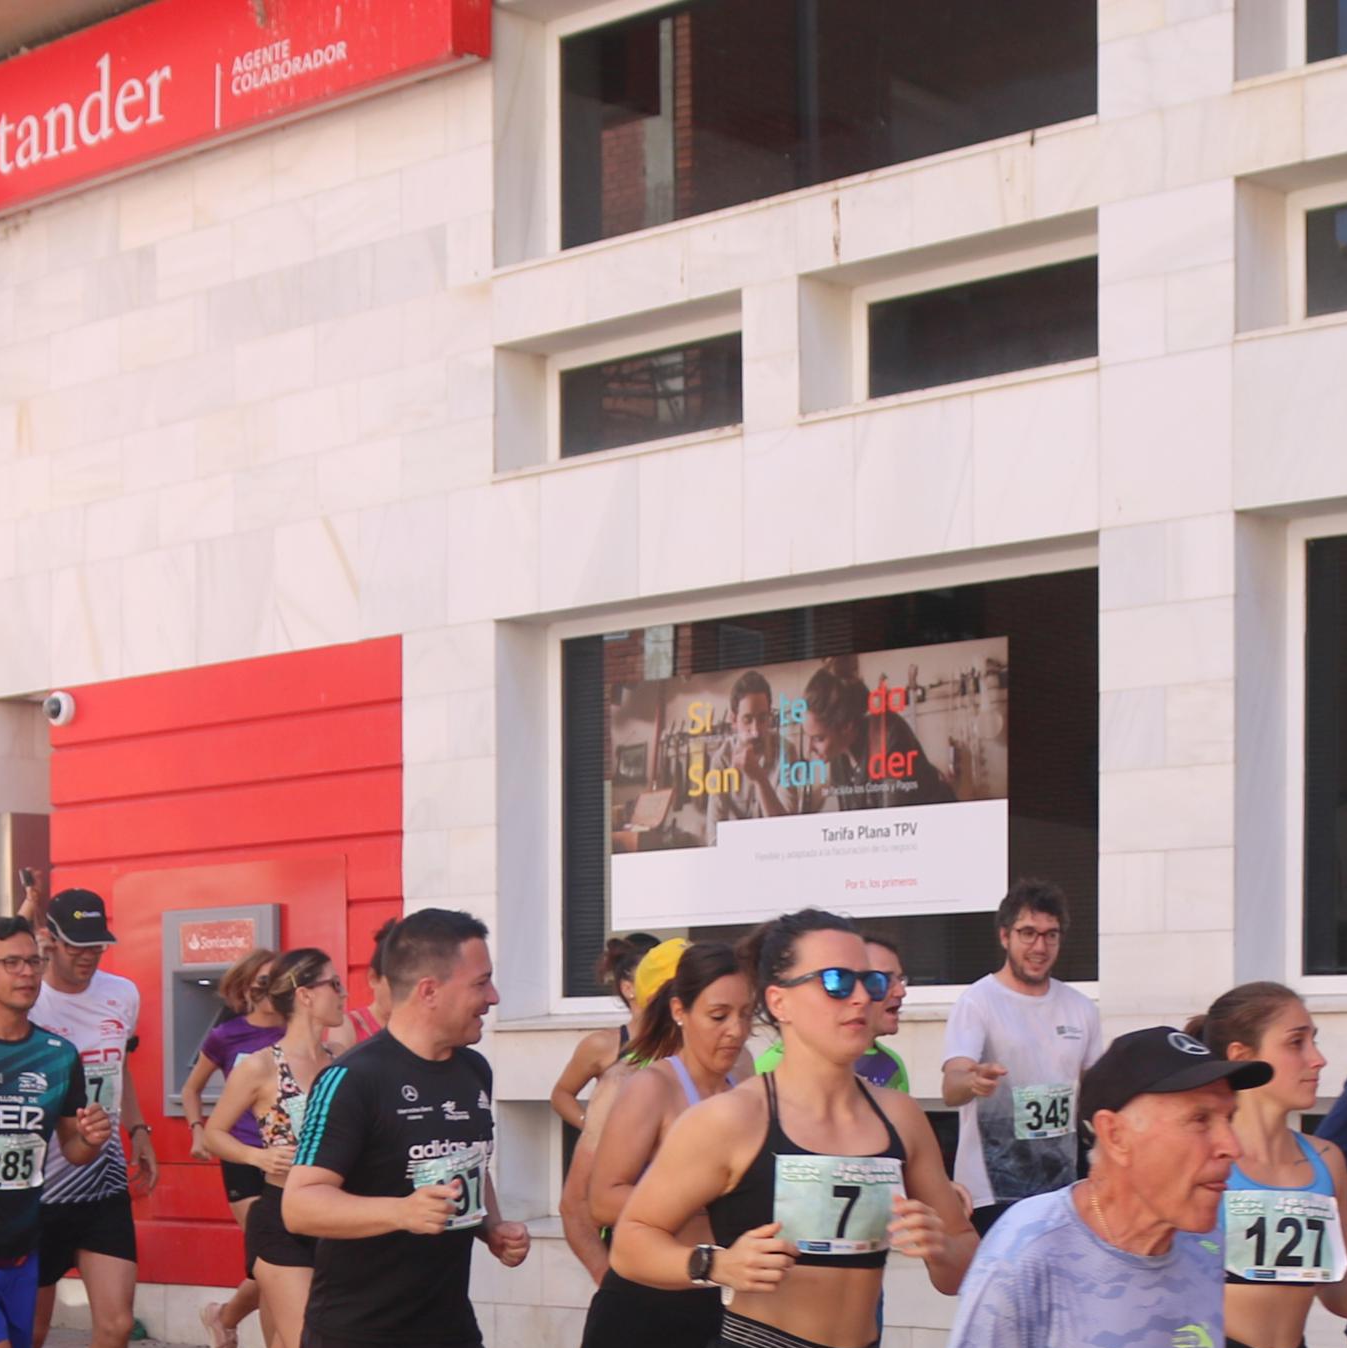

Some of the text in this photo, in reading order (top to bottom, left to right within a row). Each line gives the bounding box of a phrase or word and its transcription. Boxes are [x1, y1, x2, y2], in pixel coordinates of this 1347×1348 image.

[231, 38, 292, 75] AGENTE
[231, 41, 348, 96] COLABORADOR
[688, 680, 907, 735] Si te da
[688, 748, 919, 797] San tan der
[896, 779, 919, 792] Pagos
[821, 821, 918, 843] Tarifa Plana TPV
[845, 878, 858, 889] Por
[869, 877, 881, 888] los
[882, 876, 918, 890] primeros
[1026, 1096, 1070, 1131] 345
[408, 1140, 467, 1160] adidas
[436, 1167, 482, 1217] 97
[833, 1185, 862, 1239] 7
[1245, 1216, 1325, 1268] 127
